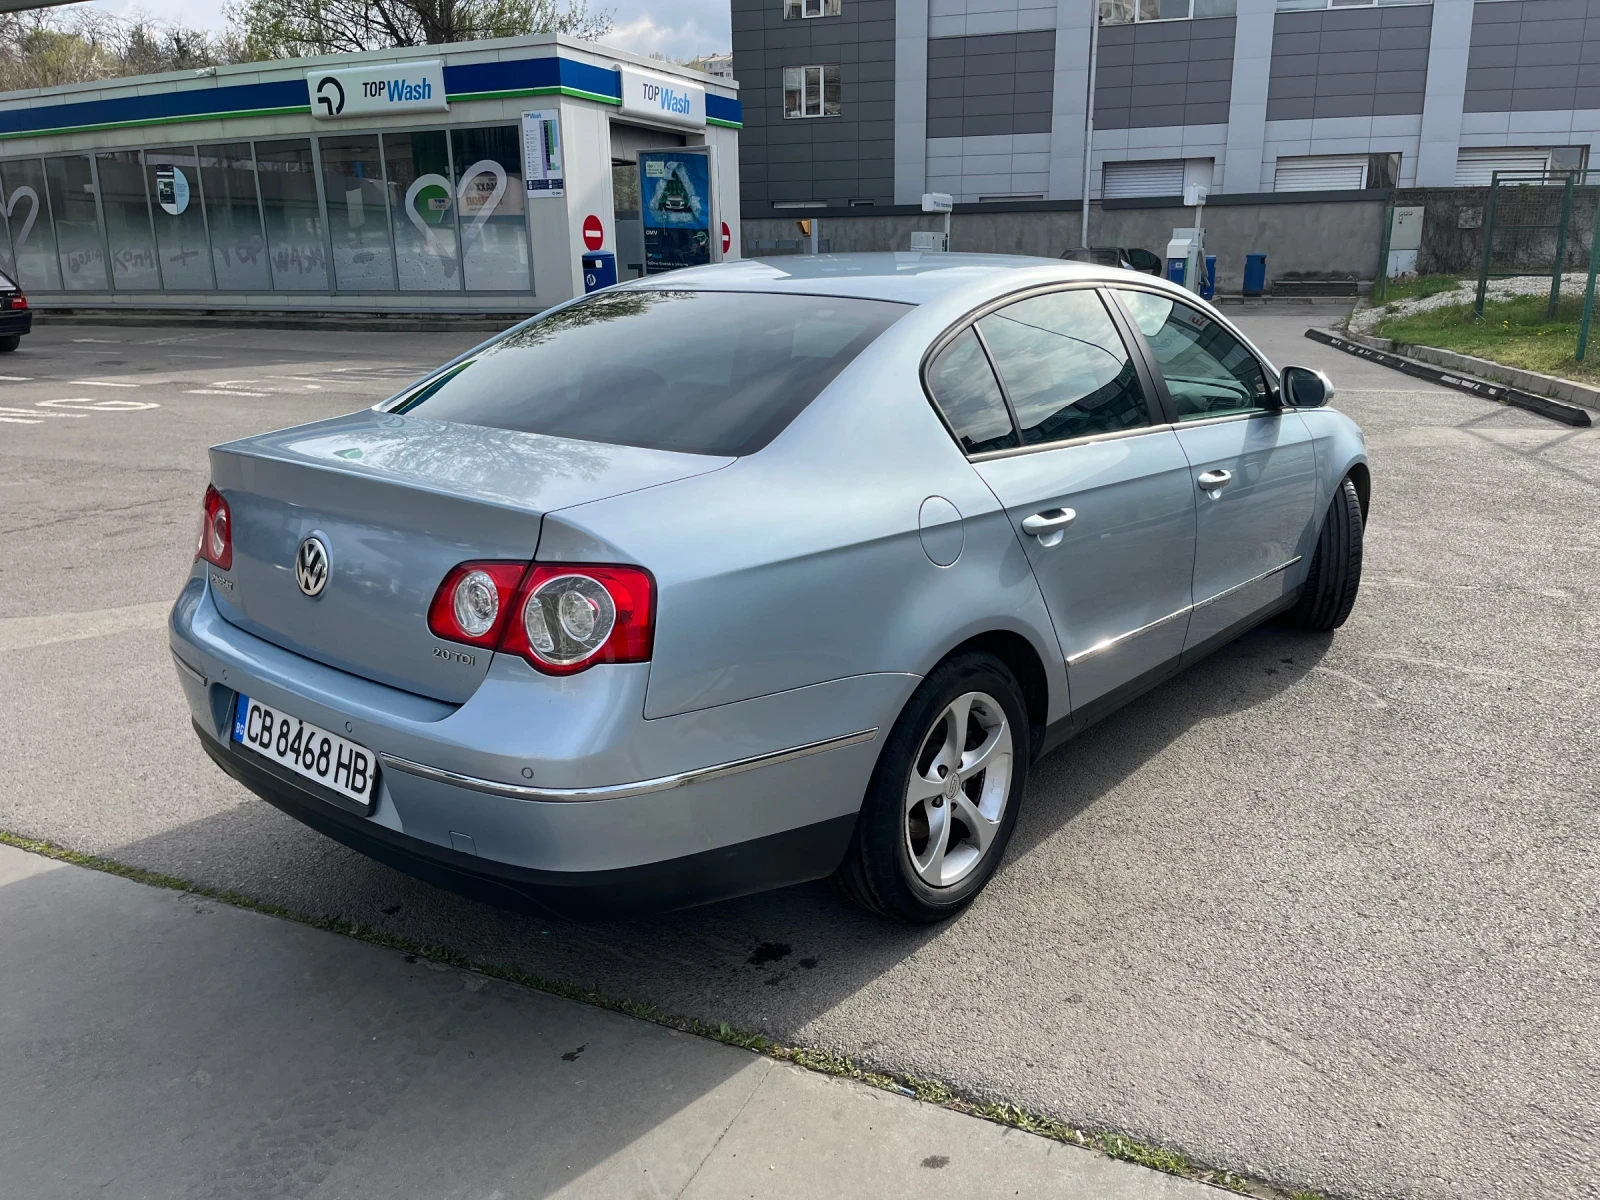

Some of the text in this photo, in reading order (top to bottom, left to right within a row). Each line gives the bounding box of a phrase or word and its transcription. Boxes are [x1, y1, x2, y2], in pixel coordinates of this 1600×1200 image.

[362, 78, 431, 102] TOP Wash
[643, 83, 690, 114] TOP Wash
[235, 723, 245, 736] BG
[247, 705, 368, 794] CB 8468 HB
